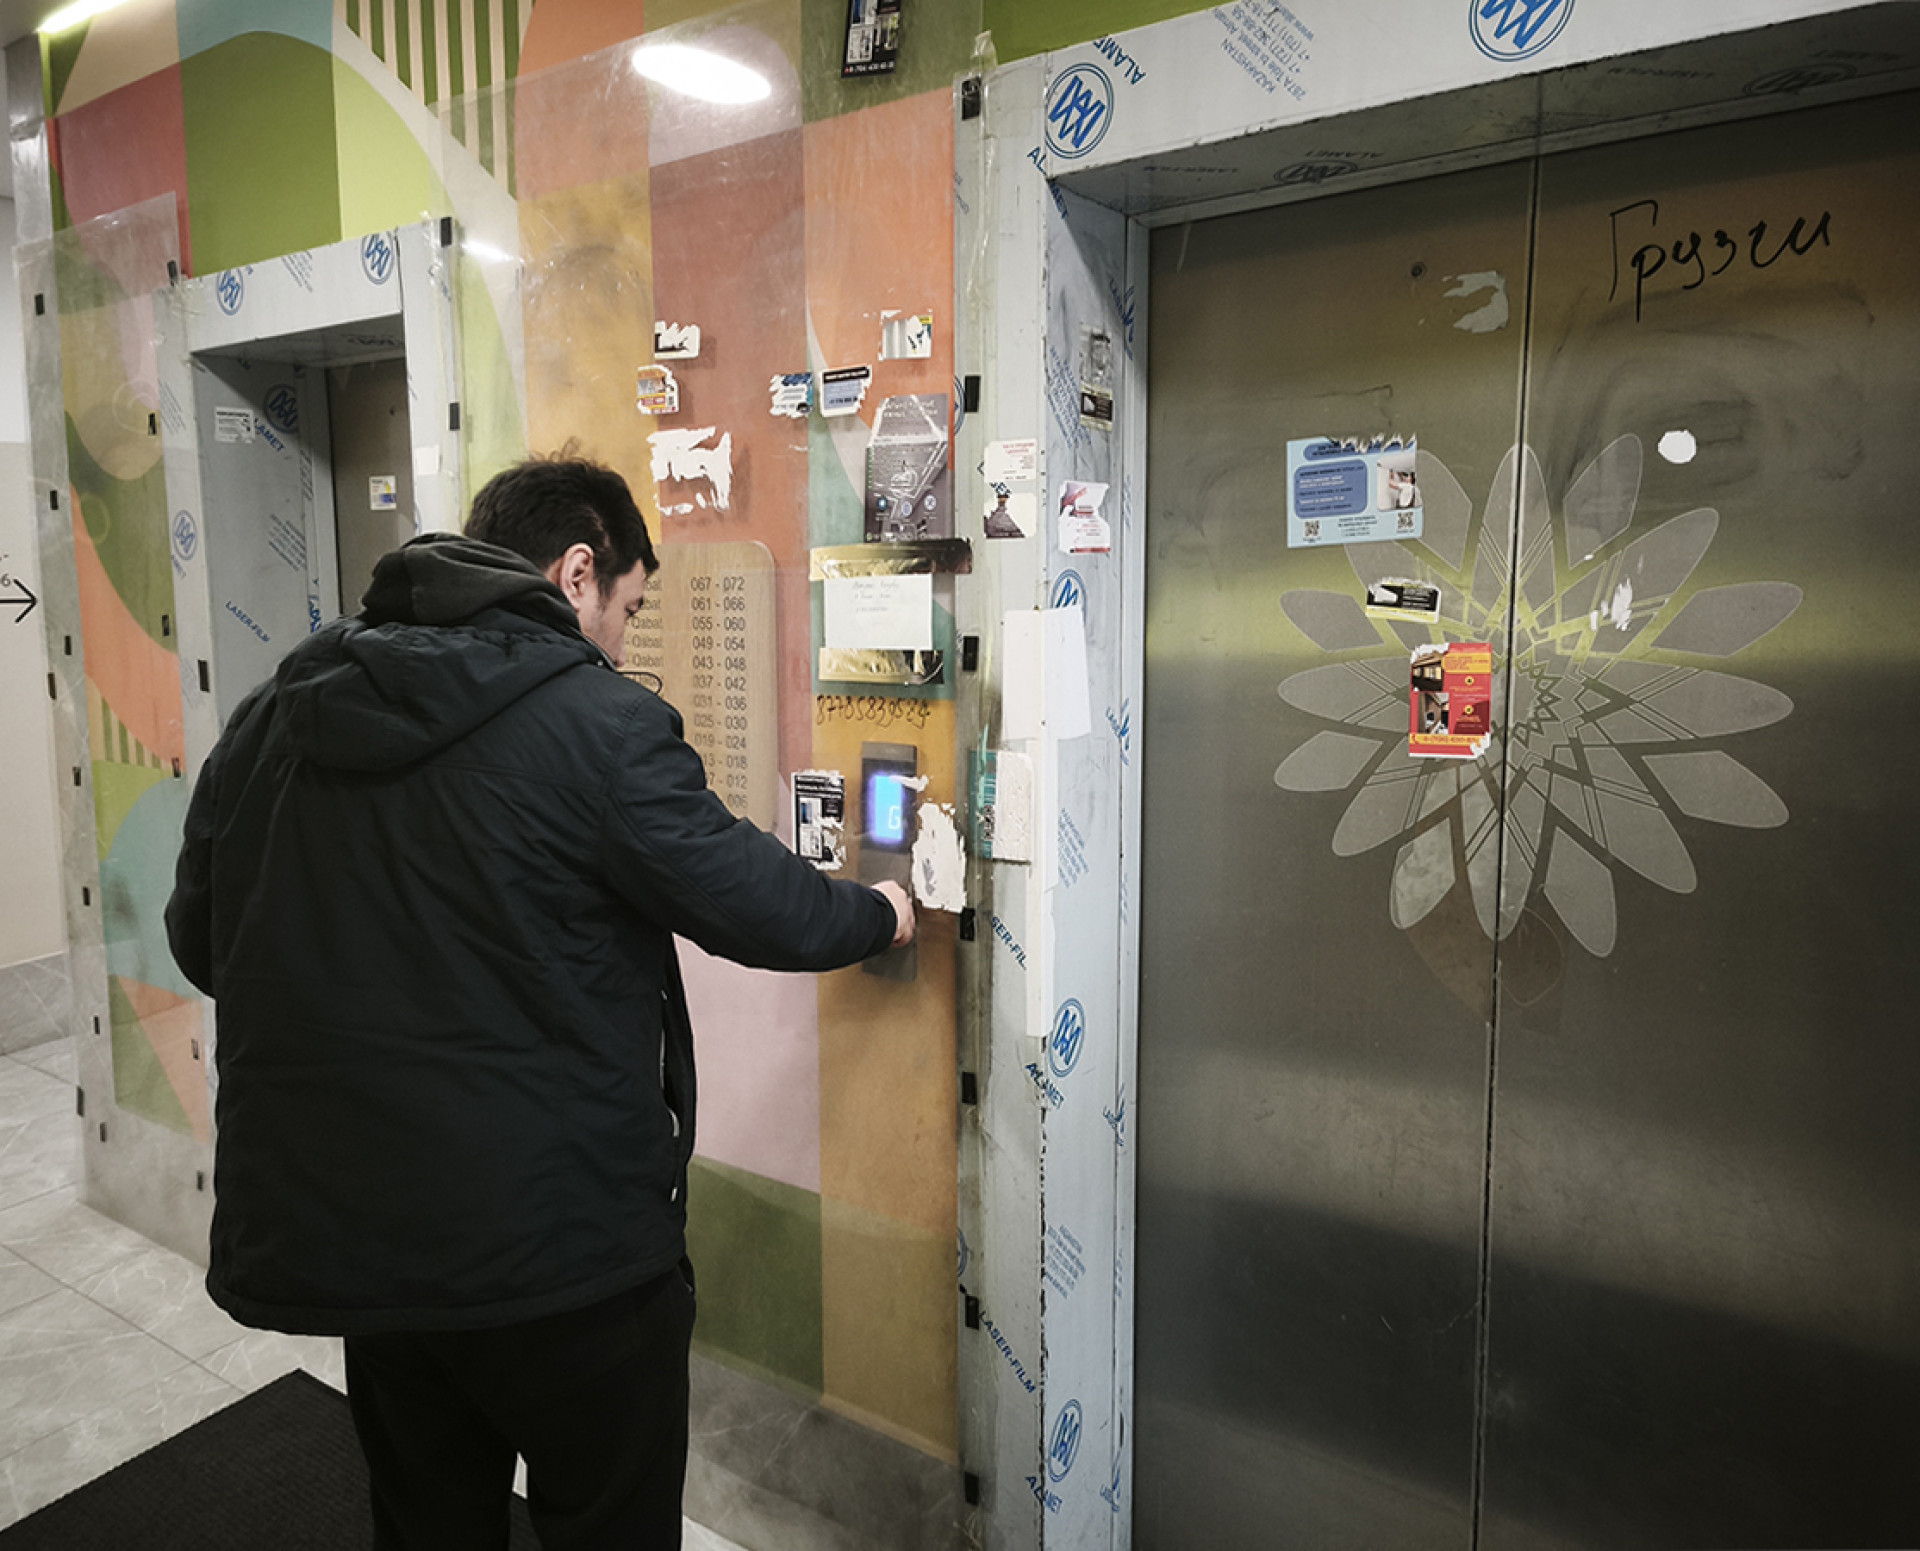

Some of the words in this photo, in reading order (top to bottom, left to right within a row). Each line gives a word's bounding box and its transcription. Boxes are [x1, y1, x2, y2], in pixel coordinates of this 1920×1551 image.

[690, 576, 711, 591] 067
[723, 577, 745, 592] 072
[691, 596, 711, 611] 061
[692, 617, 713, 630] 055
[724, 617, 746, 631] 060
[692, 635, 713, 650] 049
[724, 636, 745, 651] 054
[692, 655, 714, 669] 043
[725, 656, 746, 671] 048
[725, 676, 746, 691] 042
[725, 696, 747, 711] 036
[725, 715, 748, 730] 030
[725, 735, 746, 750] 024
[726, 754, 748, 770] 018
[726, 774, 748, 790] 012
[979, 1311, 1037, 1394] LASER-FILM
